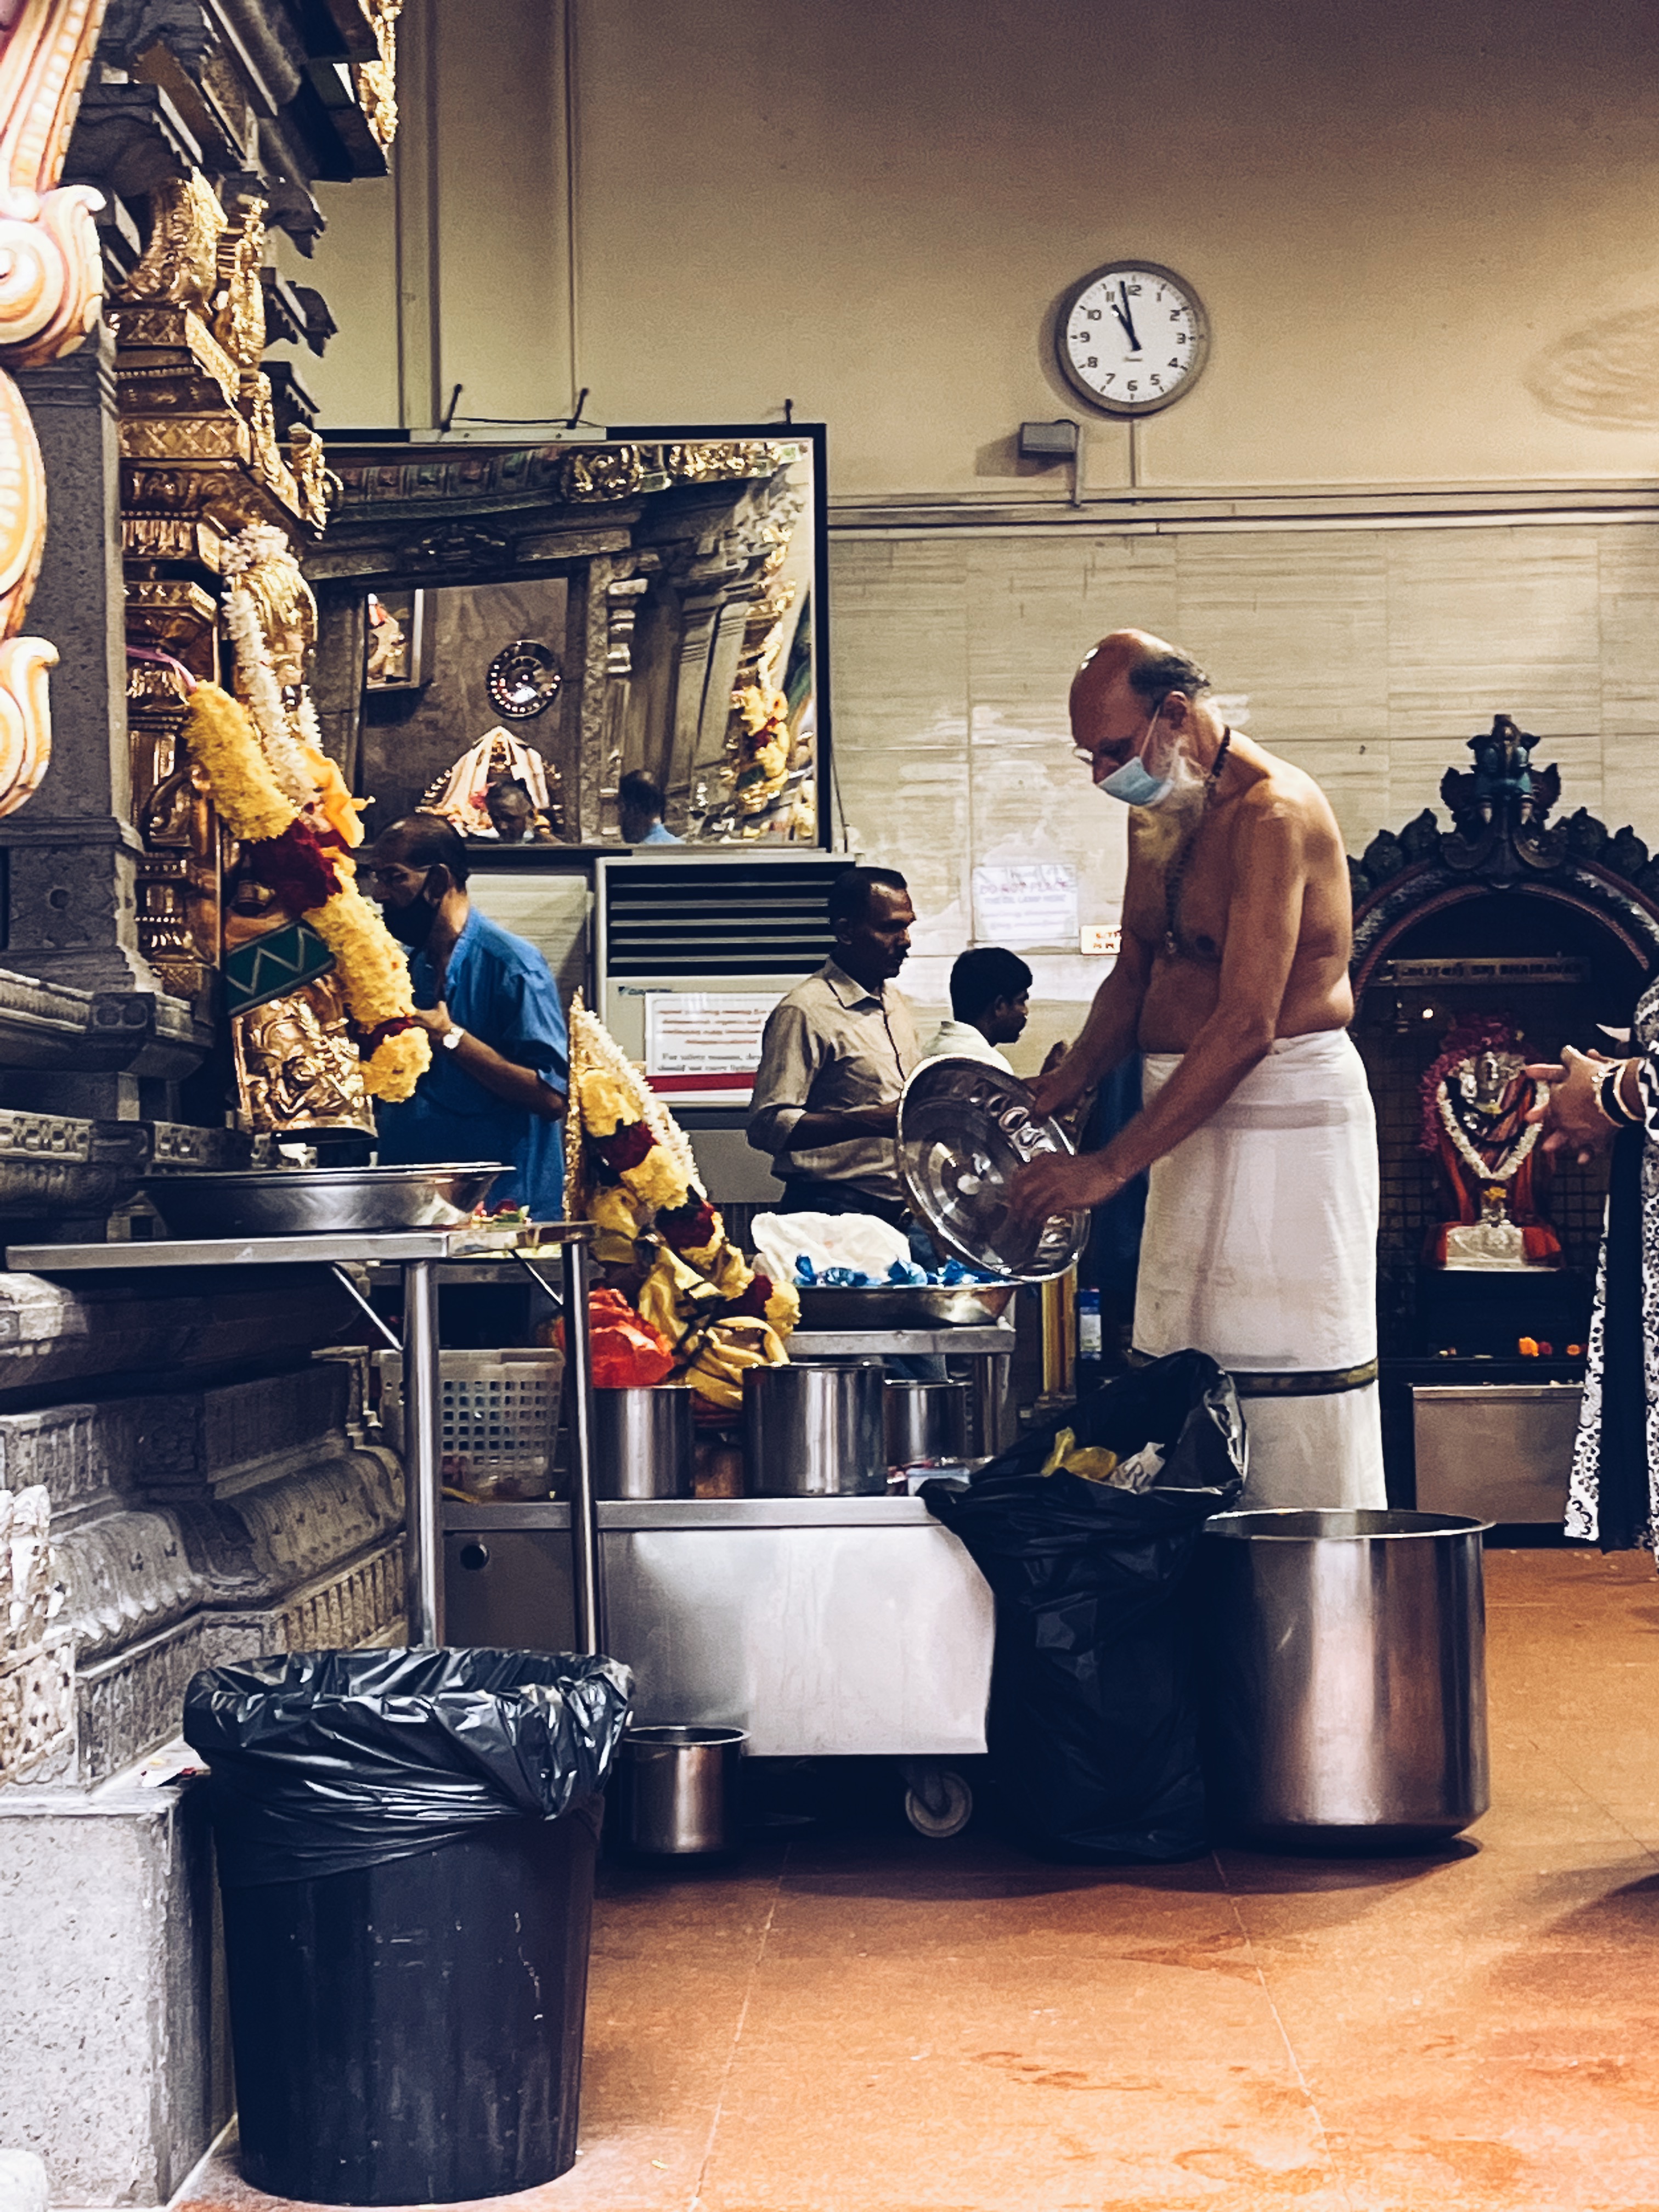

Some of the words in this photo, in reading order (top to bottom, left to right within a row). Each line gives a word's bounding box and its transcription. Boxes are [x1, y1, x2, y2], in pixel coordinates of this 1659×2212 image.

[1105, 291, 1115, 302] 11
[1156, 292, 1162, 302] 1
[1087, 309, 1102, 321] 10
[1170, 309, 1180, 321] 2
[1080, 331, 1090, 343] 9
[1177, 332, 1186, 344] 3
[1088, 357, 1098, 368] 8
[1168, 358, 1178, 368] 4
[1105, 373, 1116, 384] 7
[1150, 374, 1160, 385] 5
[1127, 380, 1138, 391] 6
